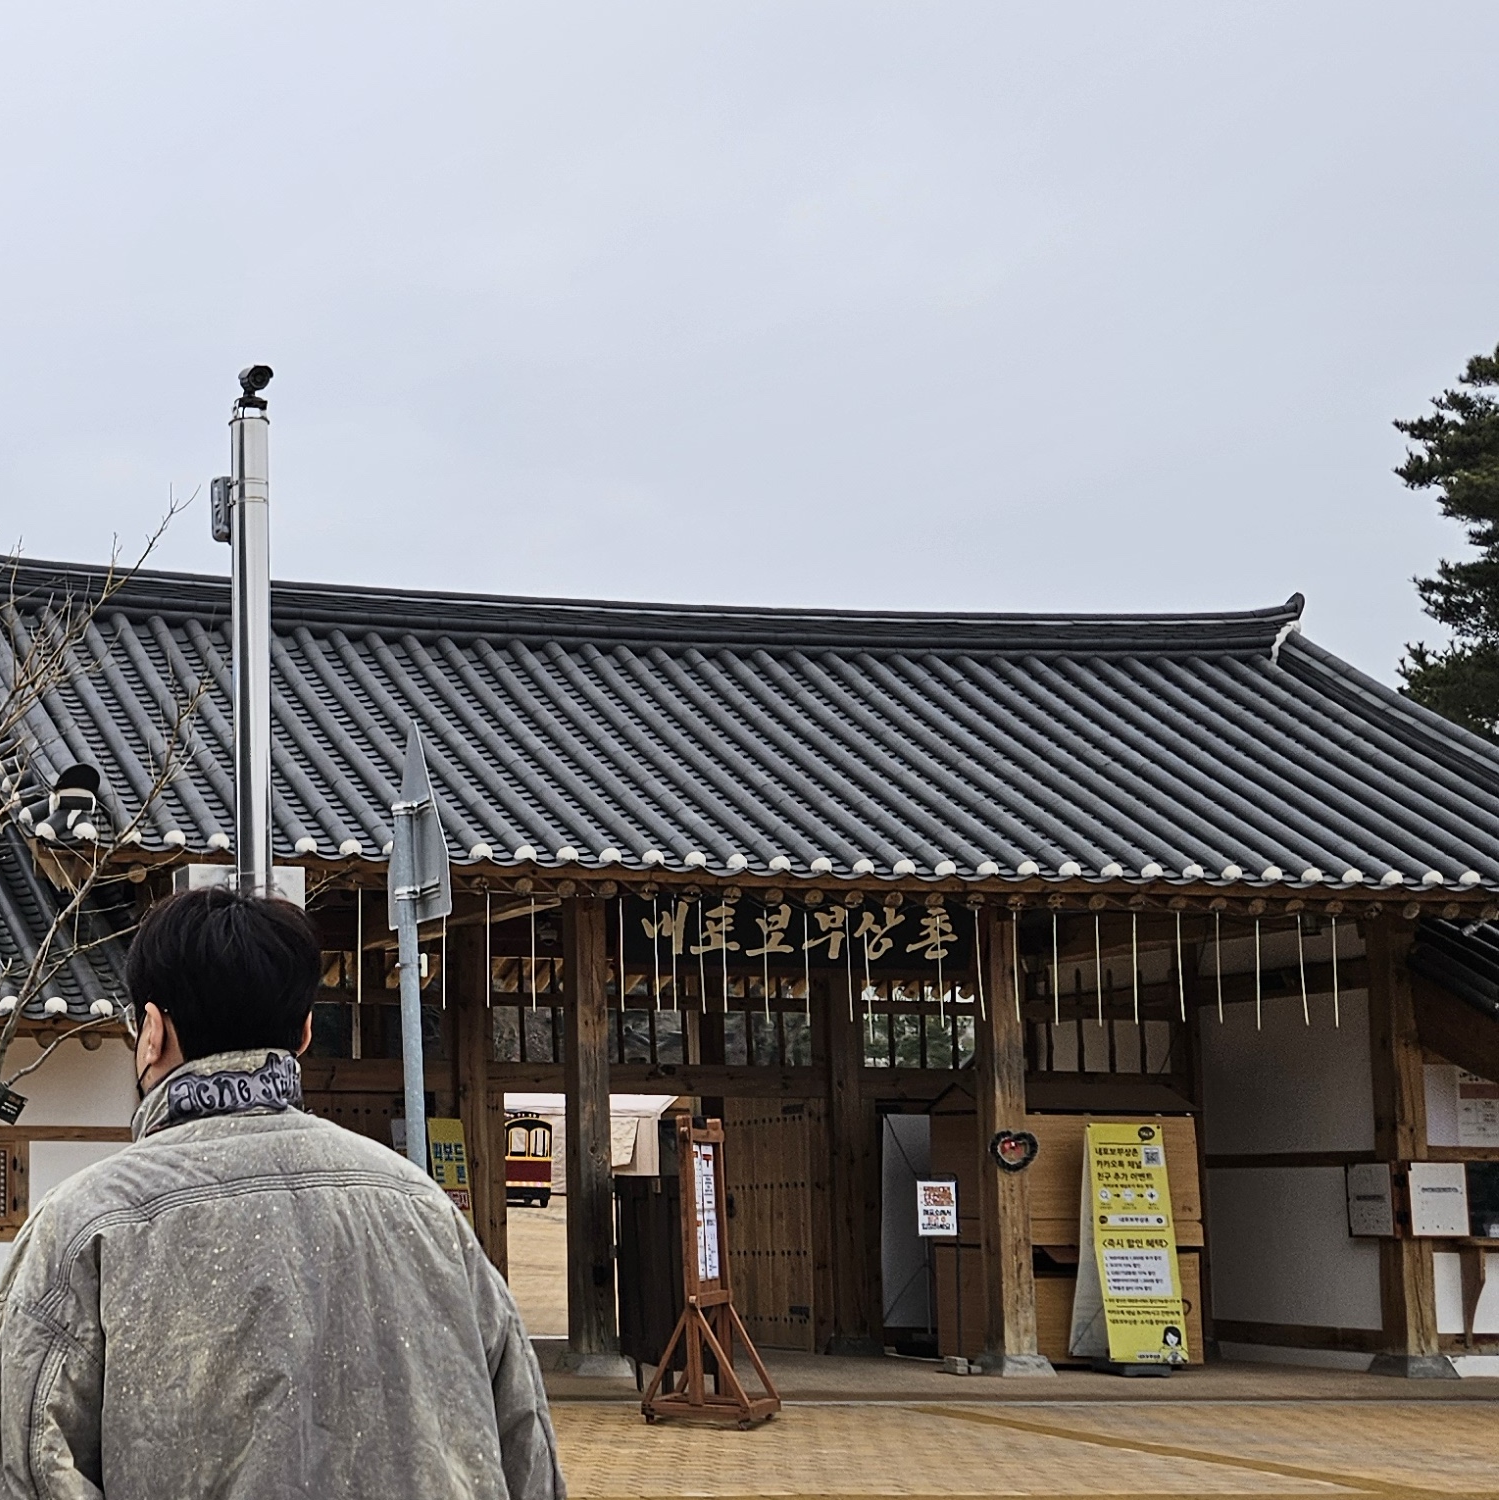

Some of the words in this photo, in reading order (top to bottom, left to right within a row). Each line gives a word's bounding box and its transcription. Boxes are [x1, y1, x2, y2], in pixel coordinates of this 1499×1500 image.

[641, 900, 958, 960] 내포보부상촌
[173, 1076, 251, 1116] acne
[1096, 1160, 1125, 1169] 카카오톡
